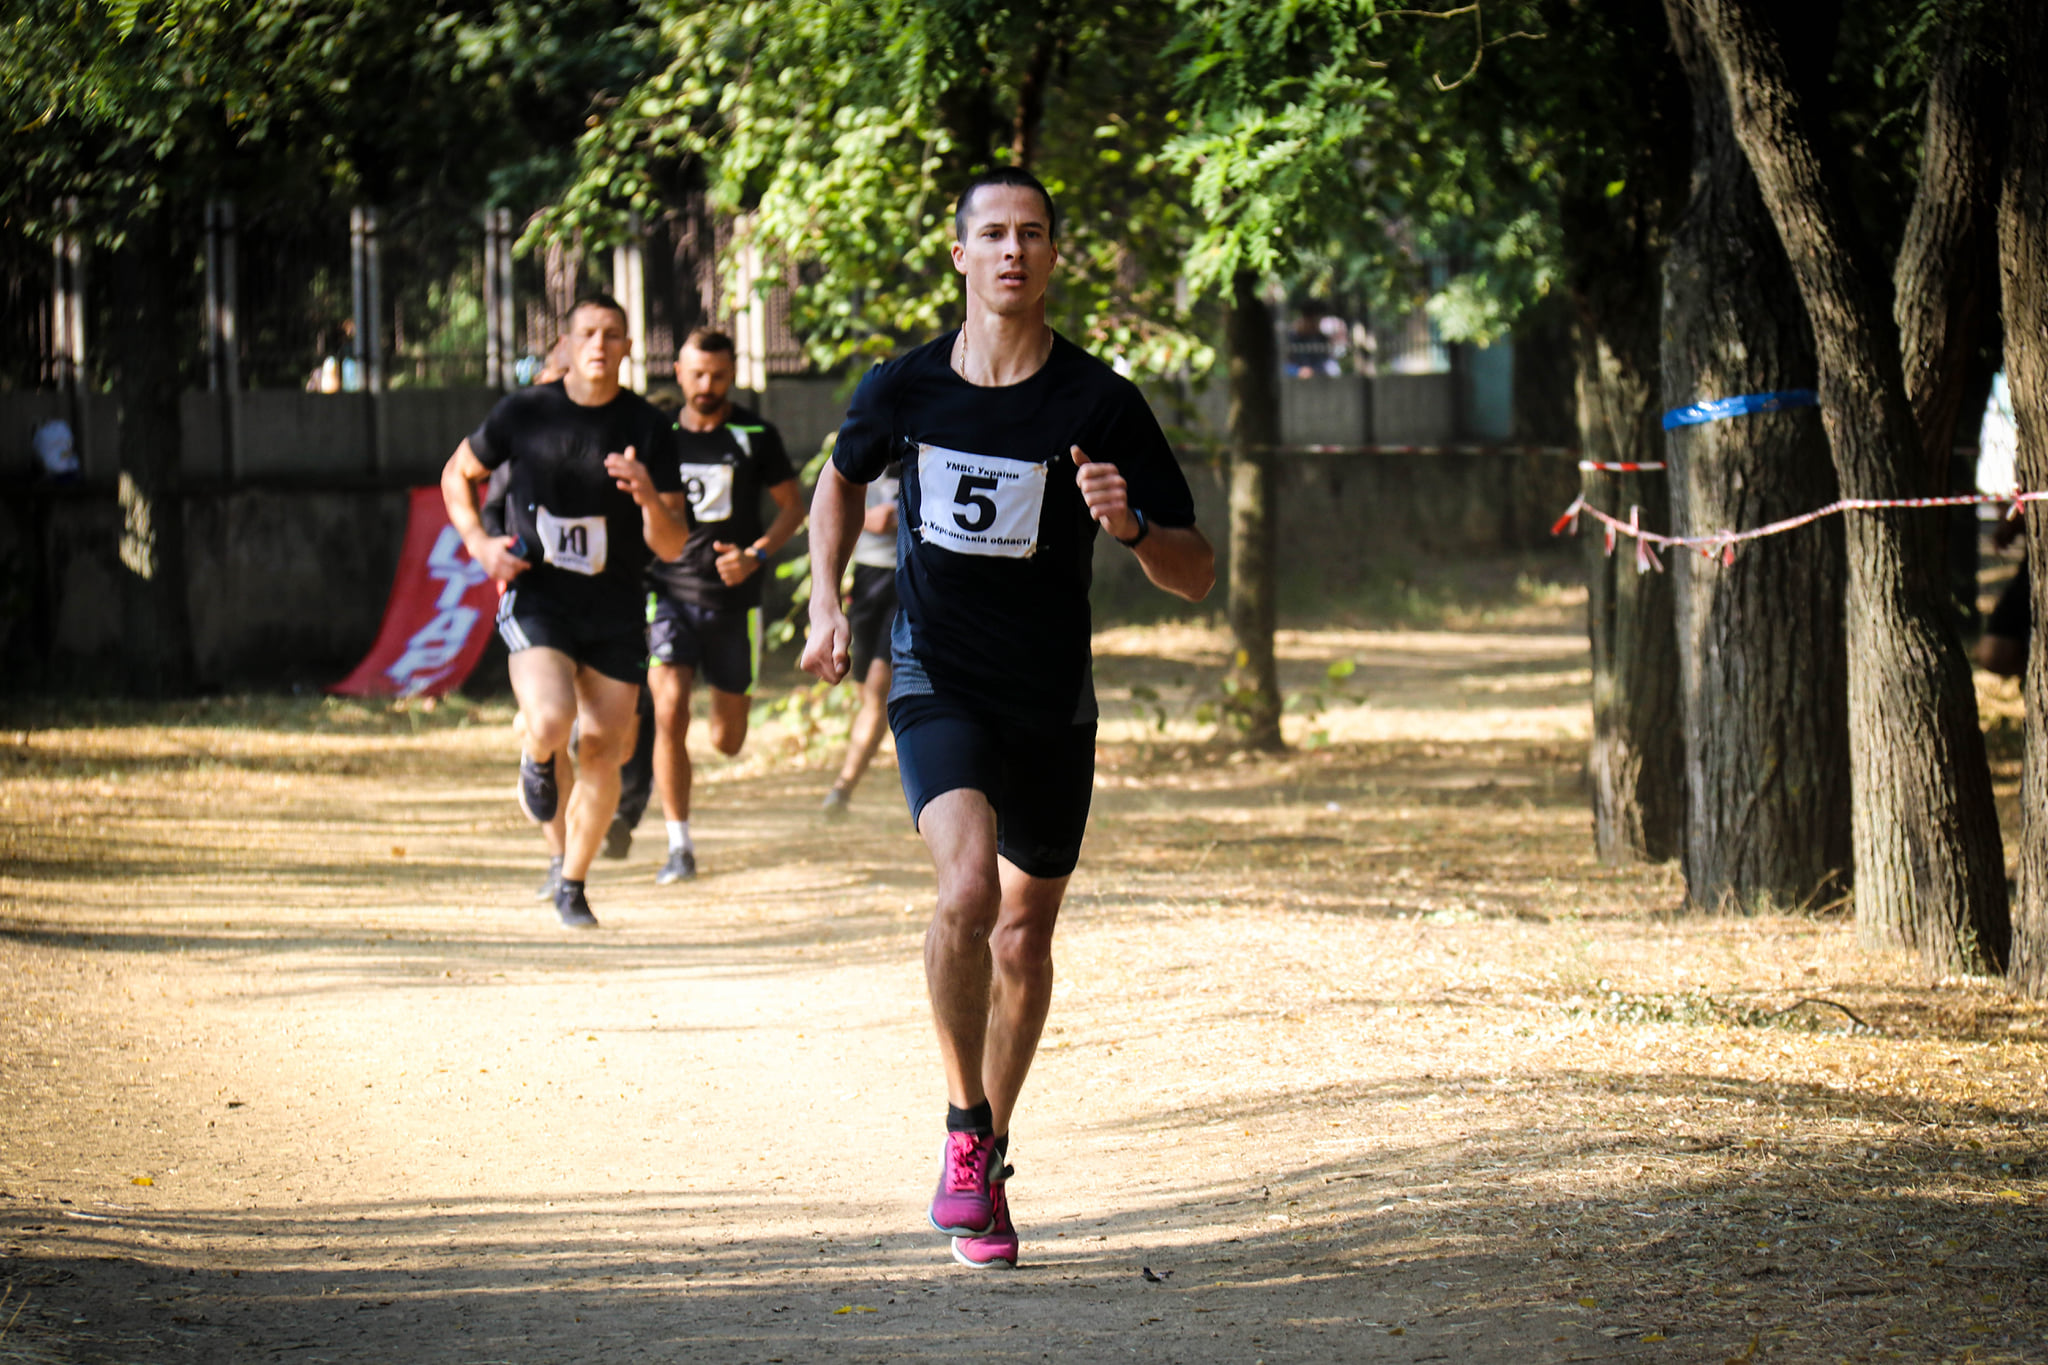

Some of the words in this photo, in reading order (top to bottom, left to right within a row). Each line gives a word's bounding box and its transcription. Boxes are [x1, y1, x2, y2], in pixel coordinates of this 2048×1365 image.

[945, 461, 975, 474] УМВС
[978, 466, 1020, 480] України
[952, 474, 998, 532] 5
[990, 534, 1031, 546] області
